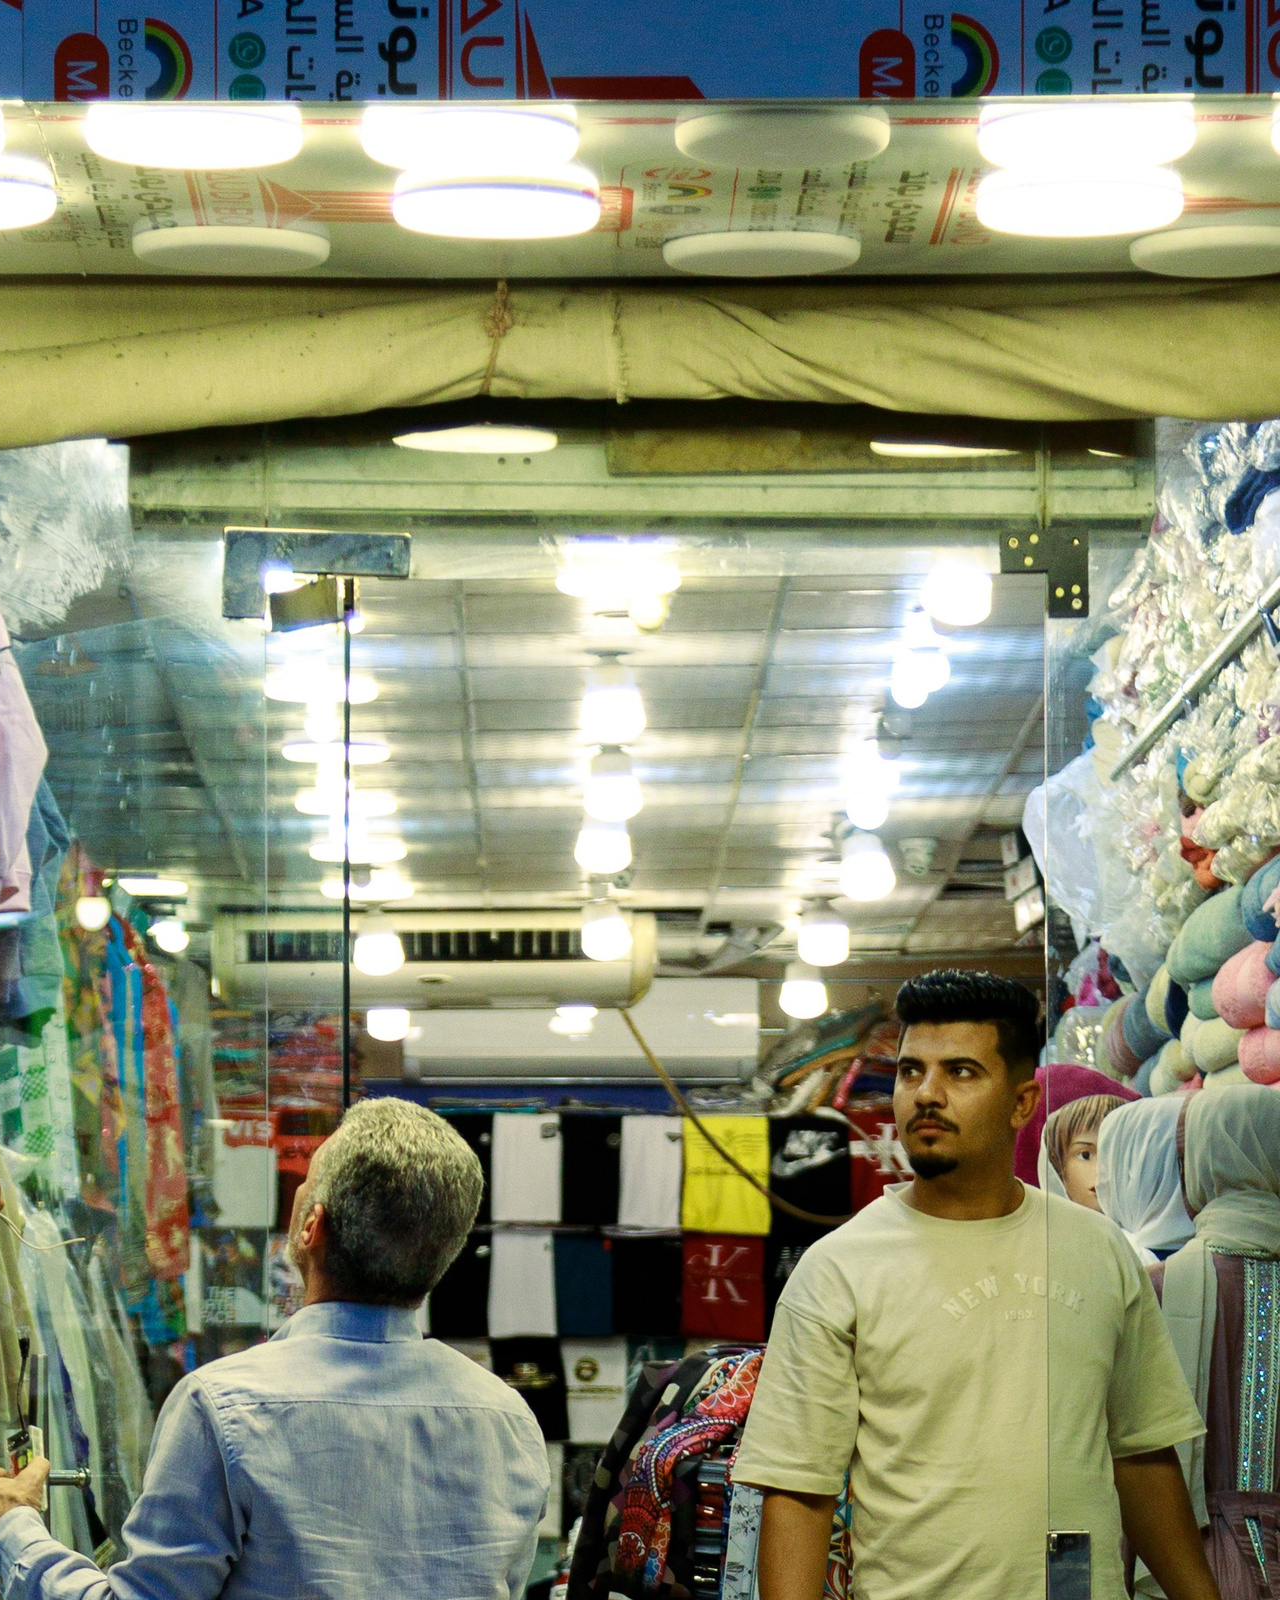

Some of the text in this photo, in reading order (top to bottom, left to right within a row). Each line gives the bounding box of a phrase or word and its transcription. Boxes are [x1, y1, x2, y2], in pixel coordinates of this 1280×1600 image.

[204, 172, 251, 205] AUDI
[941, 1272, 1086, 1322] NEW YORK
